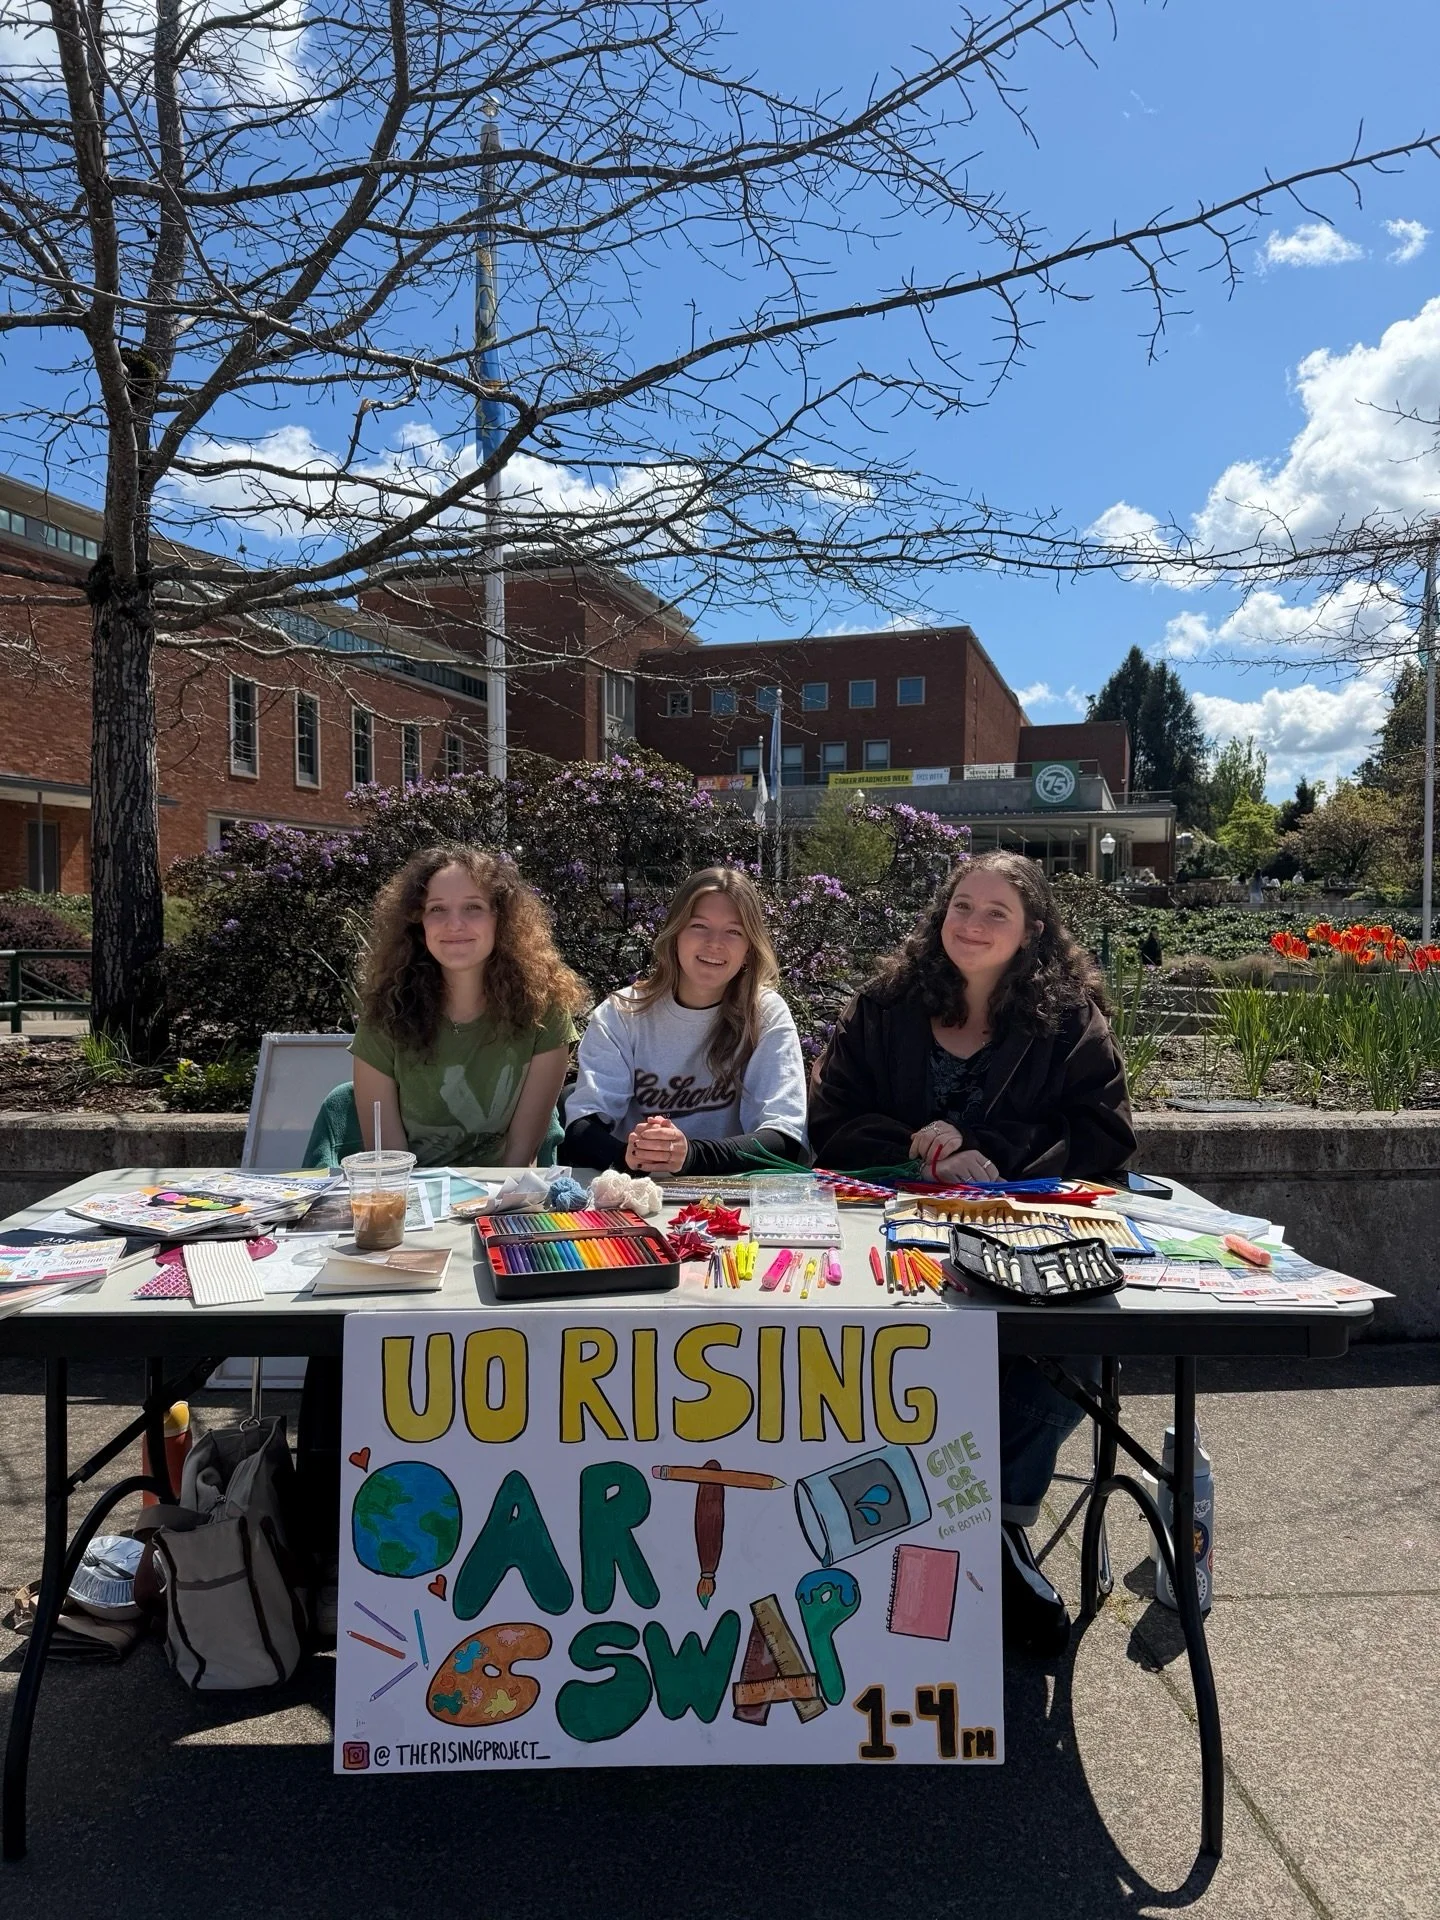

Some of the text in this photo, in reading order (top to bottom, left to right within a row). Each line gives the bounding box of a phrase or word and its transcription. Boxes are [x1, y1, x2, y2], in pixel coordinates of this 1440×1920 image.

[834, 774, 909, 785] CAREER READINESS WEEK
[1044, 775, 1067, 794] 75
[382, 1322, 937, 1445] UO RISING
[926, 1431, 981, 1478] GIVE
[946, 1465, 978, 1491] OR
[936, 1479, 993, 1519] TAKE
[452, 1459, 790, 1620] ART
[937, 1521, 957, 1540] (OR
[555, 1567, 861, 1743] SWAP
[852, 1682, 959, 1760] 1-4
[374, 1739, 551, 1766] @ THERISINGPROJECT_
